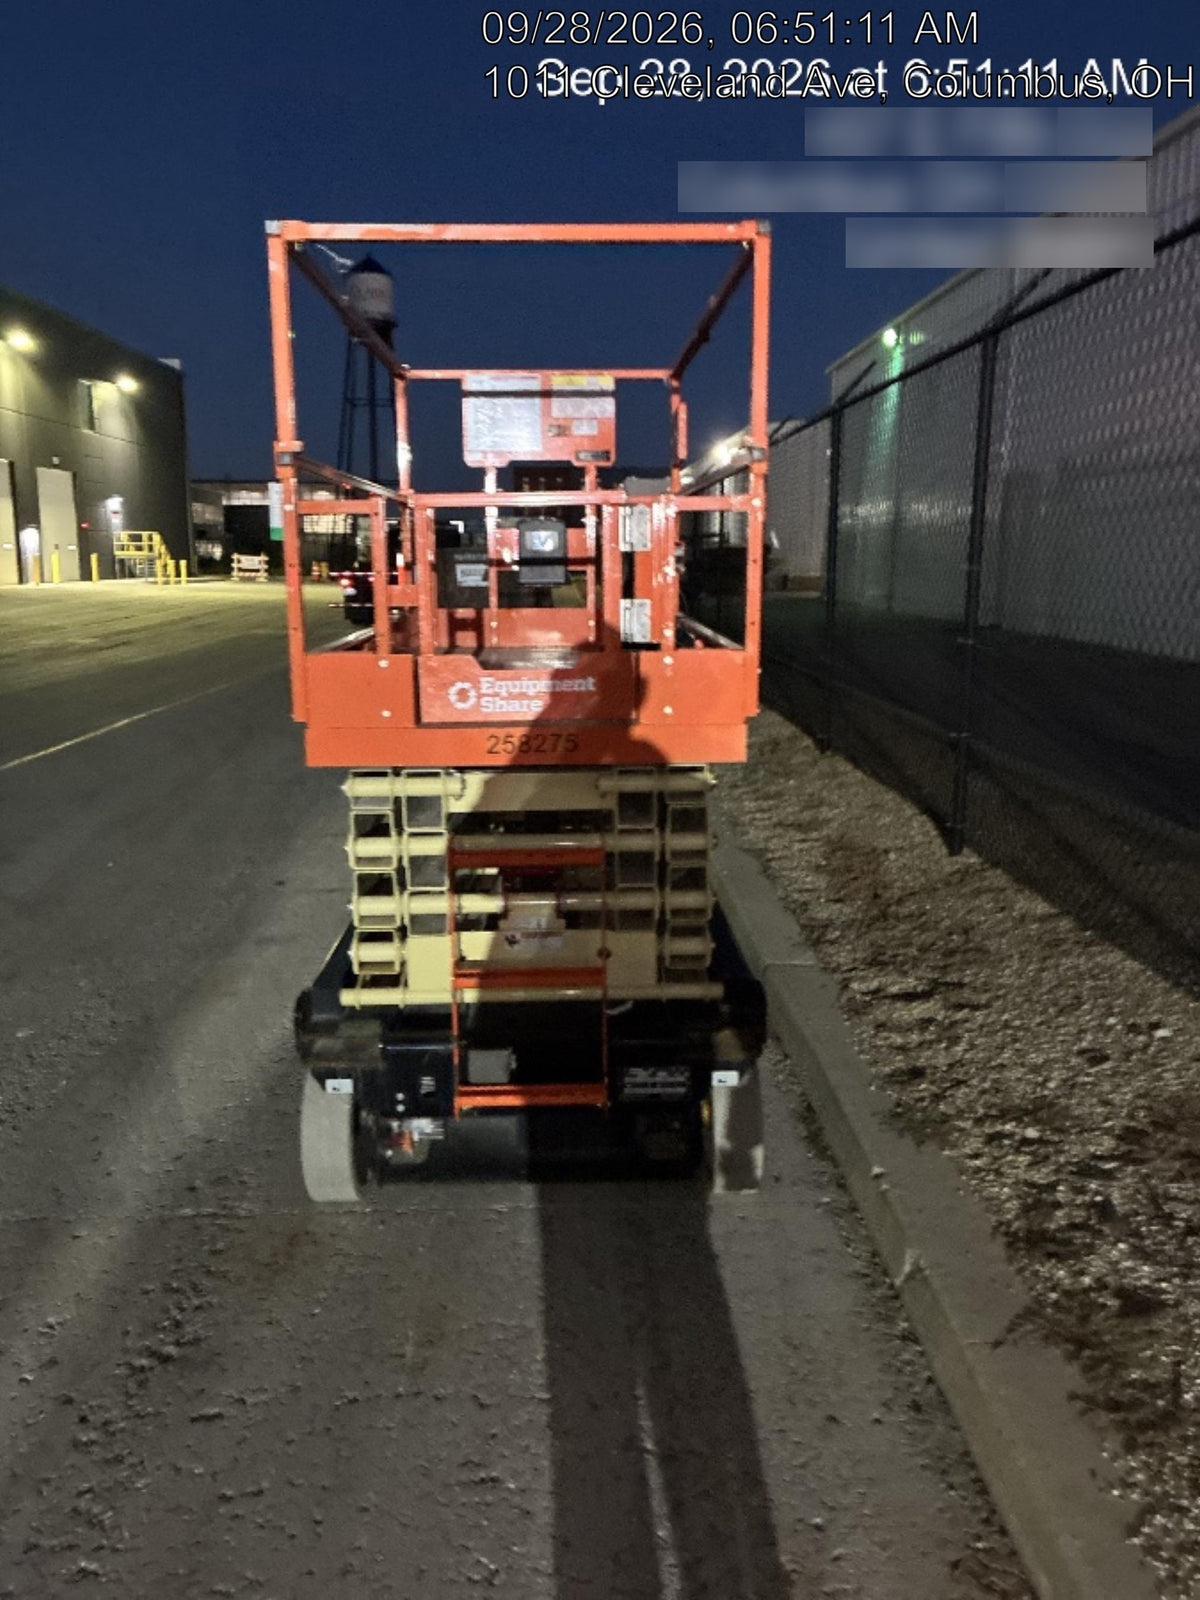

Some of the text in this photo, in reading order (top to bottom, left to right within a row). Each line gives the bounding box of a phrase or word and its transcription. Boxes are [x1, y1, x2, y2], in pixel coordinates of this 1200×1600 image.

[479, 676, 596, 695] Equipment
[479, 697, 544, 712] Share
[486, 733, 579, 754] 258275
